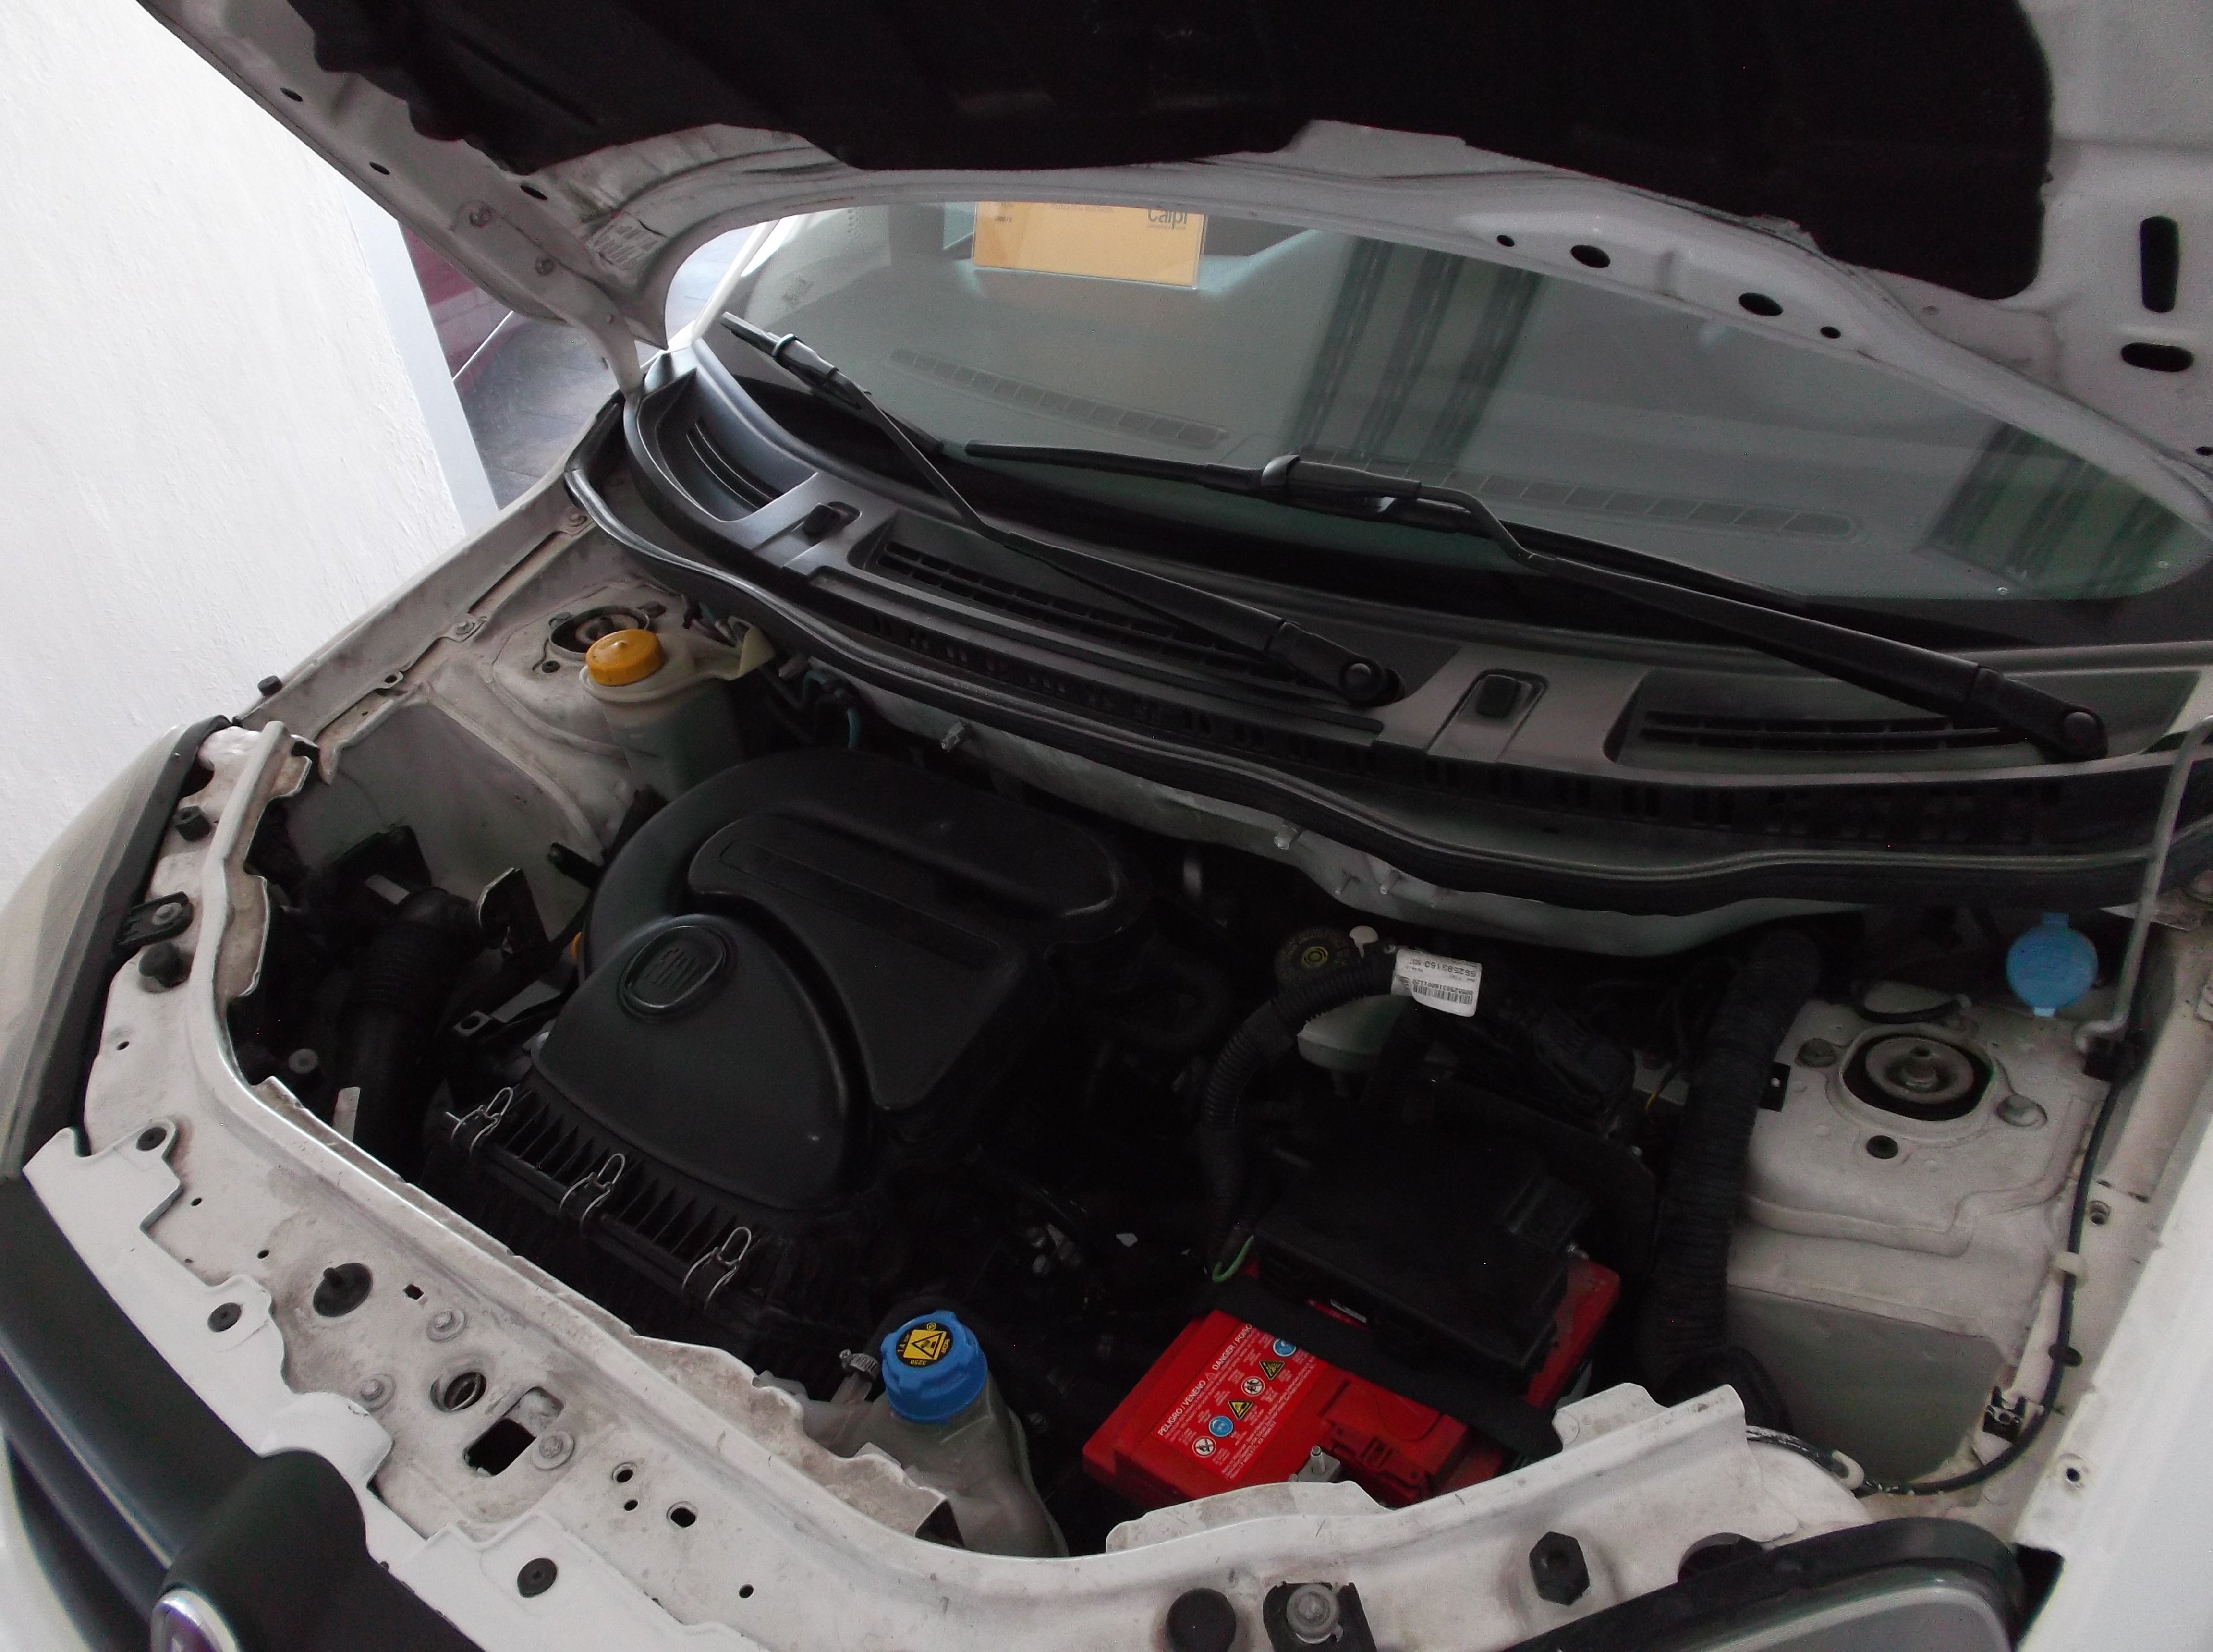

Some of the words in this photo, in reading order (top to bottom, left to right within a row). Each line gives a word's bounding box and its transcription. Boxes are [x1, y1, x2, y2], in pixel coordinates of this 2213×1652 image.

[1157, 1406, 1184, 1436] PELIGRO
[1182, 1379, 1207, 1406] VENENO
[1212, 1344, 1235, 1371] DANGER
[1234, 1323, 1253, 1343] POISO
